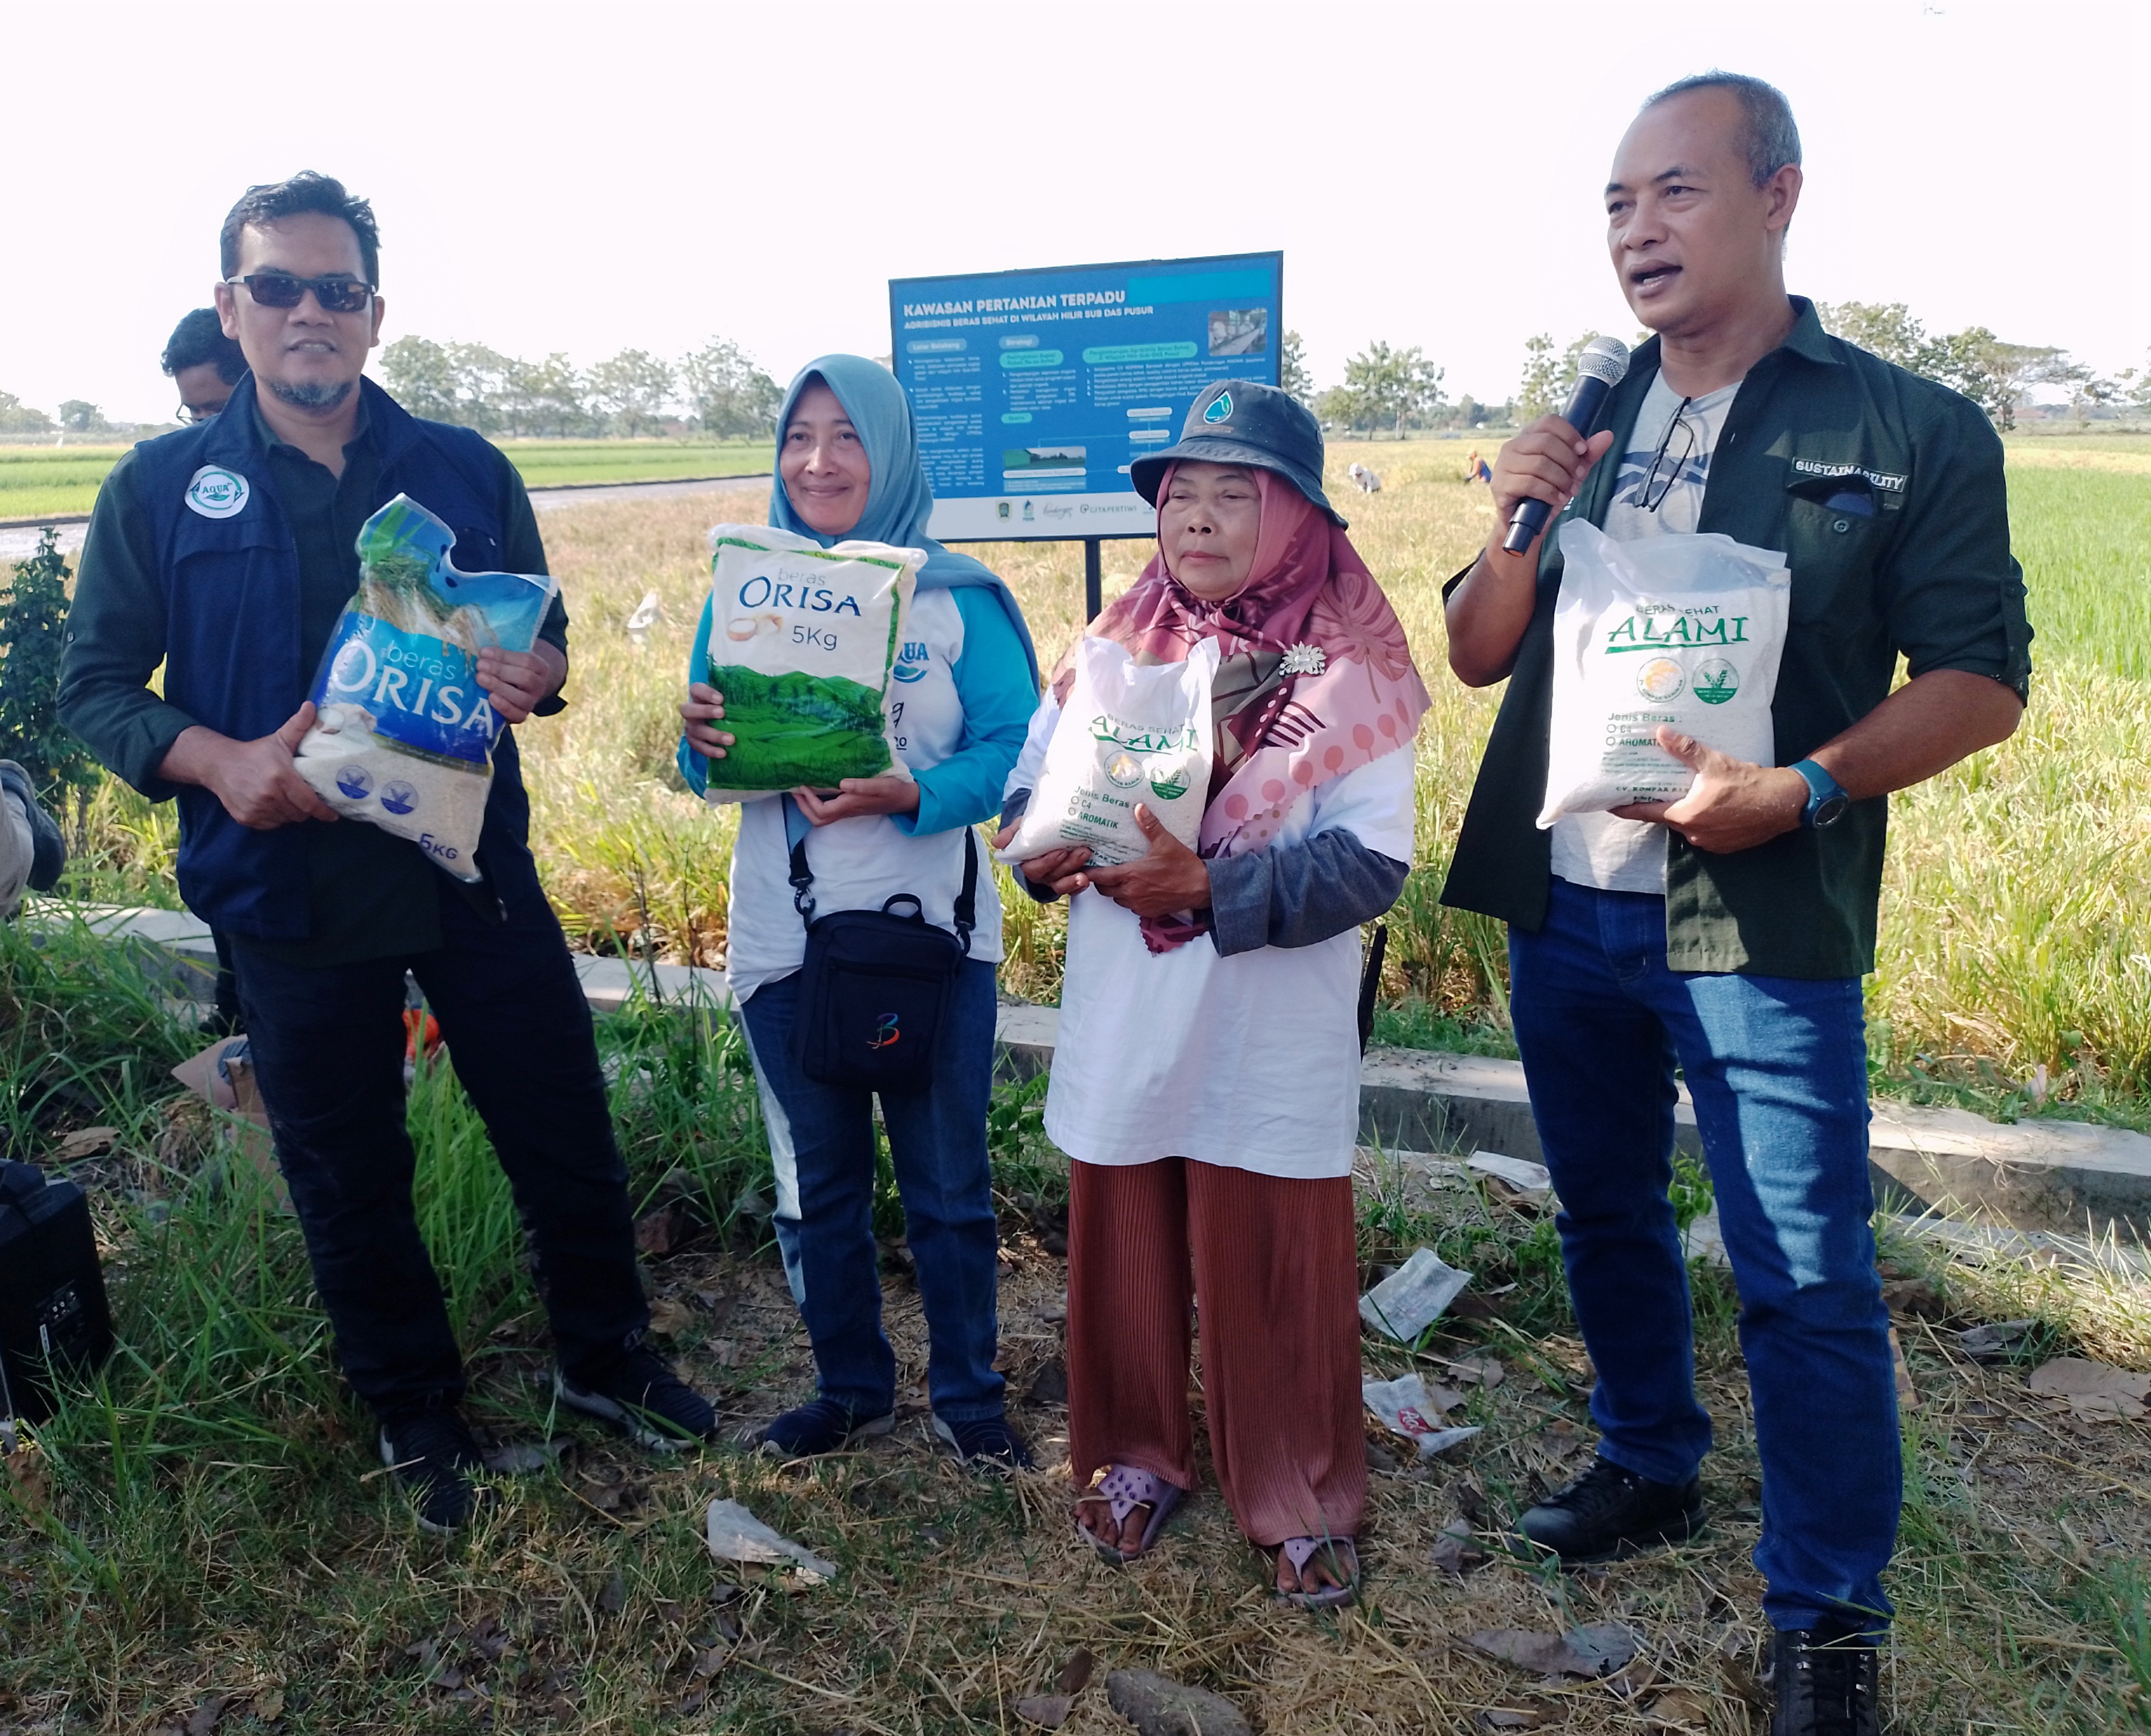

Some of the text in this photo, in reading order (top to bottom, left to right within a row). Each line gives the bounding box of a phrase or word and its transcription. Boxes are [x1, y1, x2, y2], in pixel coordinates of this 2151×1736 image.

[903, 290, 1126, 317] KAWASAN PERTANIAN TERPADU
[904, 305, 1153, 329] AGRIBISNIS BERAS SEHAT DI WILAYAH HILIR SUB DAS PUSUR
[203, 484, 229, 494] AQUA
[777, 567, 827, 586] beras
[738, 576, 862, 617] ORISA
[792, 625, 838, 651] 5Kg
[1607, 616, 1749, 644] ALAMI
[386, 638, 457, 681] beras
[332, 640, 494, 739] ORISA
[1107, 713, 1185, 735] BERAS SEHAT
[1608, 712, 1638, 722] Jenis
[1642, 713, 1675, 723] Beras
[1088, 714, 1199, 752] ALAMI
[1074, 785, 1130, 809] Jenis Beras
[1081, 800, 1092, 810] C4
[1078, 810, 1119, 829] AROMATIK
[418, 832, 459, 861] 5KG
